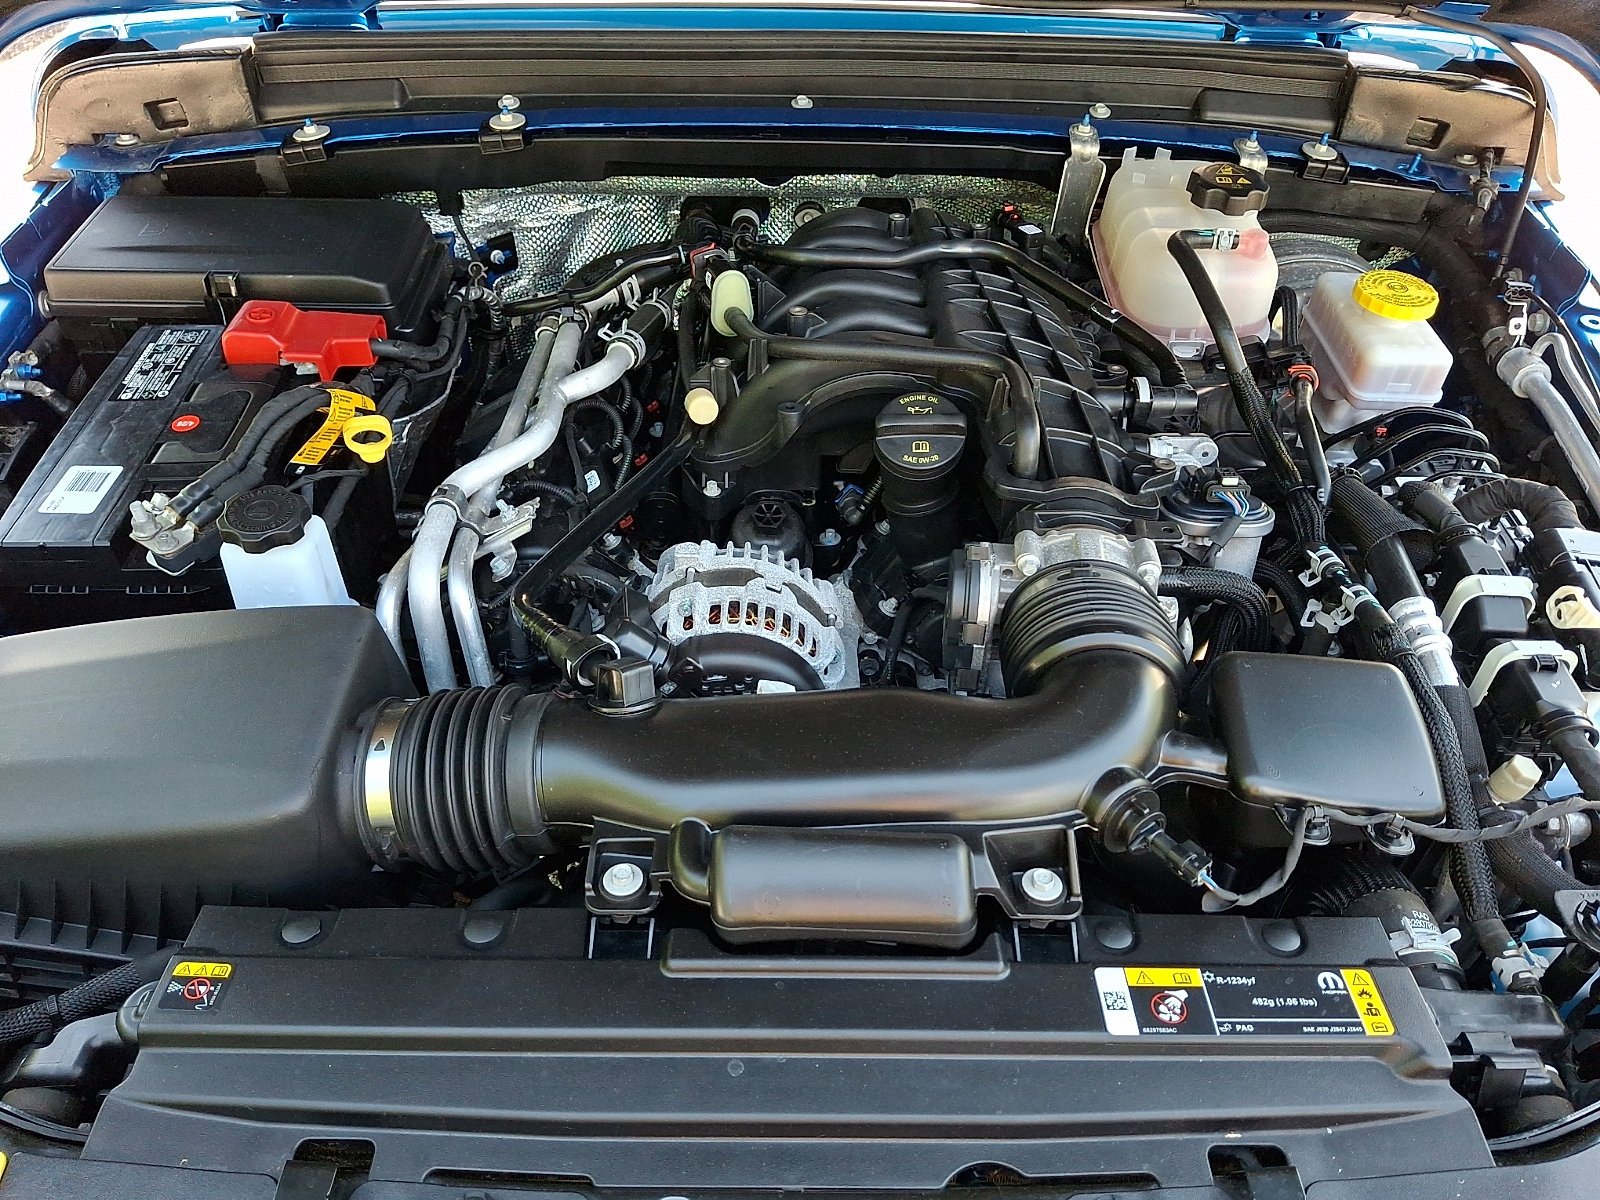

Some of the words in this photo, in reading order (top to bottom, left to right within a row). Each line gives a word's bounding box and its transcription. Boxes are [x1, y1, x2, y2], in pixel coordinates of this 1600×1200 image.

[899, 394, 927, 404] ENGINE
[928, 396, 939, 404] OIL
[902, 454, 918, 464] SAE
[918, 454, 939, 464] 0W-20
[1411, 910, 1430, 921] RAD
[1215, 976, 1256, 987] R-1234yf
[1299, 997, 1318, 1007] lbs)
[1235, 1024, 1254, 1032] PAG
